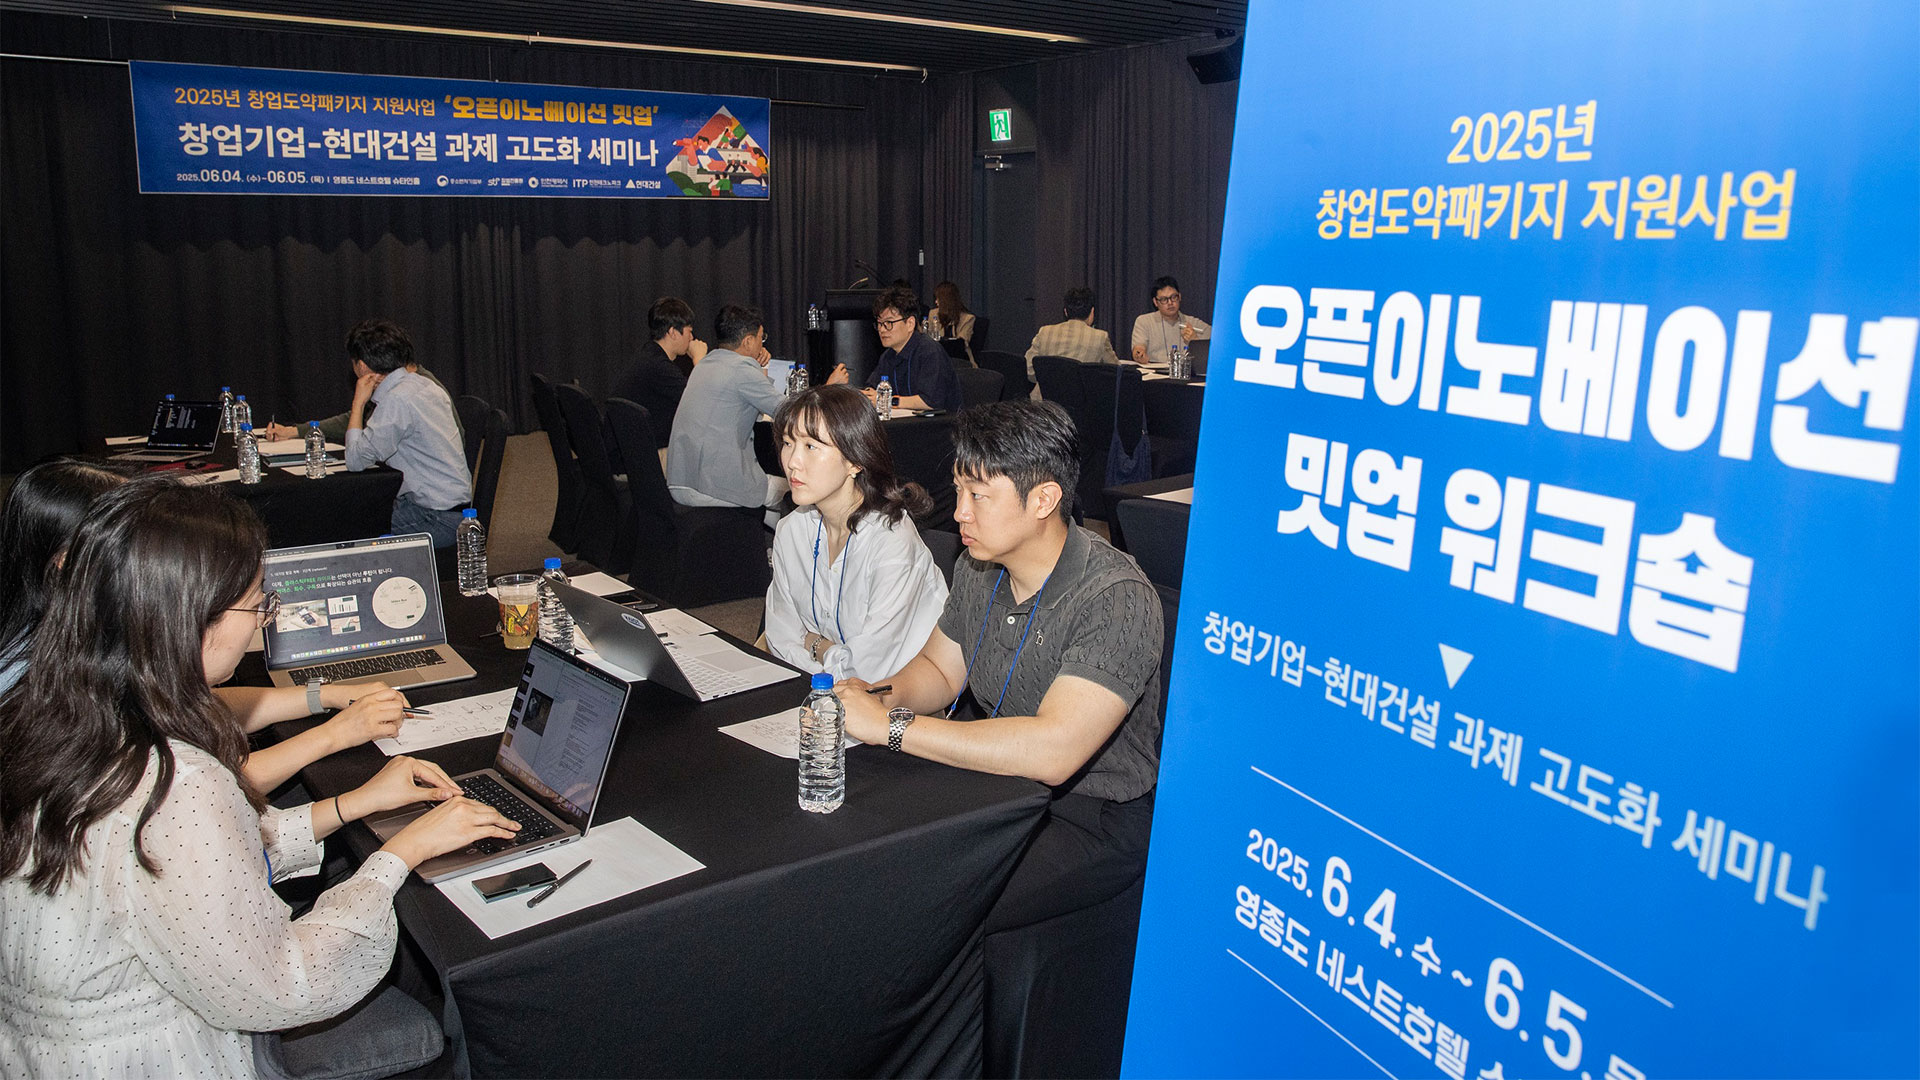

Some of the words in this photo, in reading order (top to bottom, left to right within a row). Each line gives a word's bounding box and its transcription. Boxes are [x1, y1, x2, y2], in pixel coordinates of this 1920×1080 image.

[175, 88, 240, 107] 2025년
[248, 90, 366, 113] 창업도약패키지
[373, 98, 435, 116] 지원사업
[179, 123, 437, 161] 창업기업-현대건설
[445, 133, 497, 162] 과제
[506, 136, 581, 164] 고도화
[588, 138, 659, 166] 세미나
[1447, 100, 1597, 163] 2025년
[332, 175, 355, 185] 영종도
[356, 176, 391, 185] 네스트호텔
[572, 178, 589, 188] ITP
[635, 180, 661, 189] 현대건설
[1316, 179, 1568, 239] 창업도약패키지
[1581, 169, 1796, 240] 지원사업
[1234, 285, 1919, 483] 오픈이노베이션
[1278, 433, 1422, 571] 밋업
[1440, 469, 1753, 672] 워크숍
[1203, 612, 1440, 748] 창업기업-현대건설
[1449, 713, 1522, 786] 과제
[1531, 749, 1661, 848] 고도화
[1673, 811, 1824, 927] 세미나
[1236, 886, 1310, 967] 영종도
[1316, 941, 1469, 1076] 네스트호텔
[1412, 937, 1441, 976] 수
